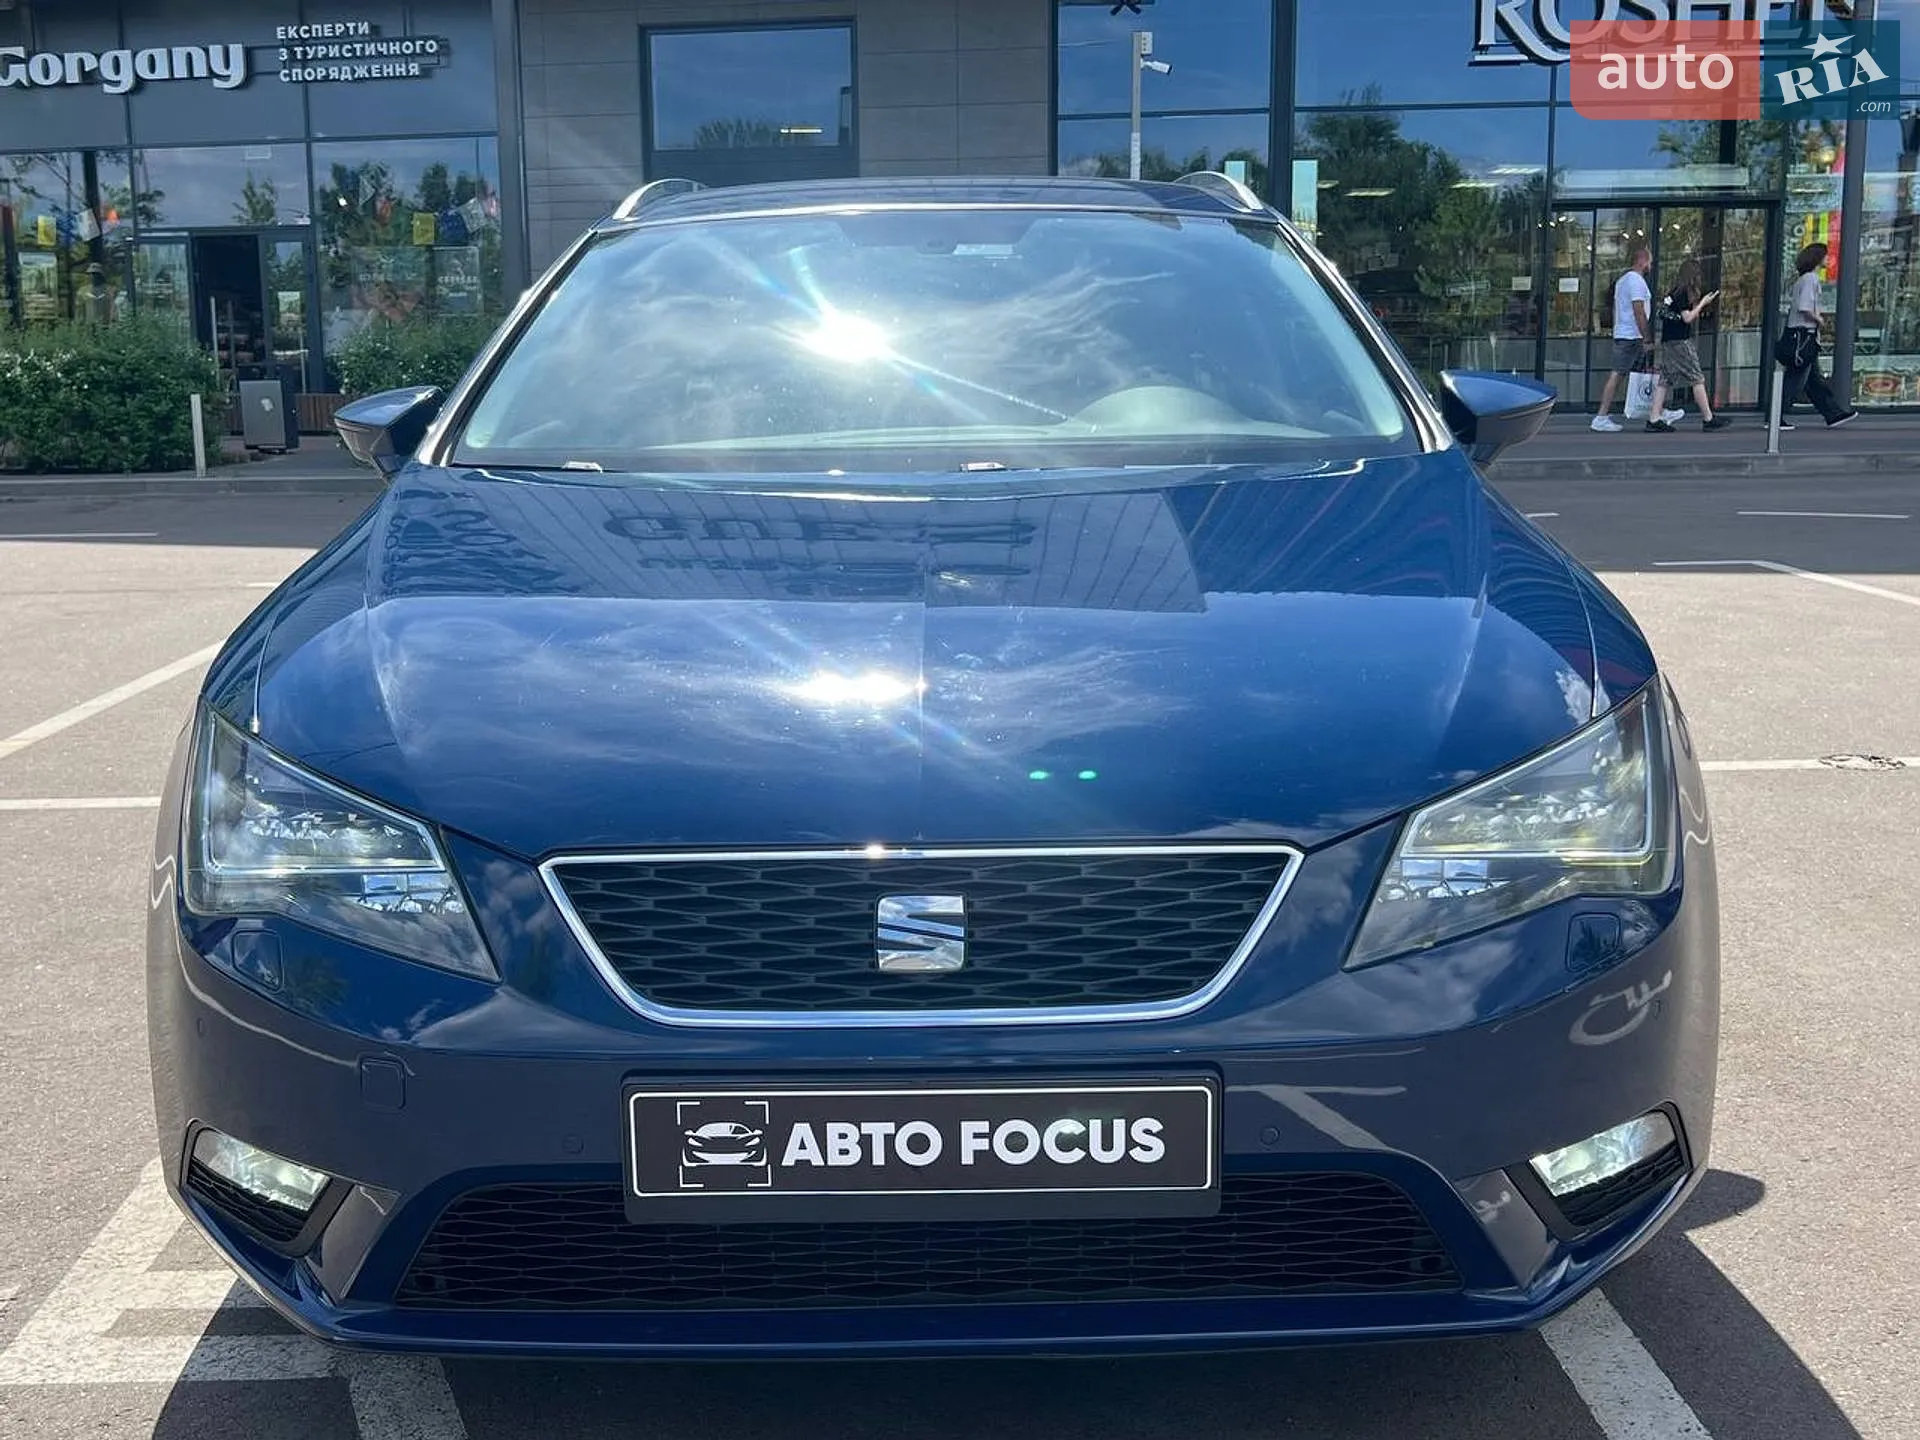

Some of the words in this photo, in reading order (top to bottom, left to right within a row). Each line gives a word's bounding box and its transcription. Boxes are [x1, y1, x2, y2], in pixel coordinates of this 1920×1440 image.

[276, 22, 370, 39] ЕКСПЕРТИ
[294, 40, 438, 59] ТУРИСТИЧНОГО
[0, 43, 245, 94] Gorgany
[280, 63, 420, 82] СПОРЯДЖЕННЯ
[960, 1117, 1166, 1165] FOCUS
